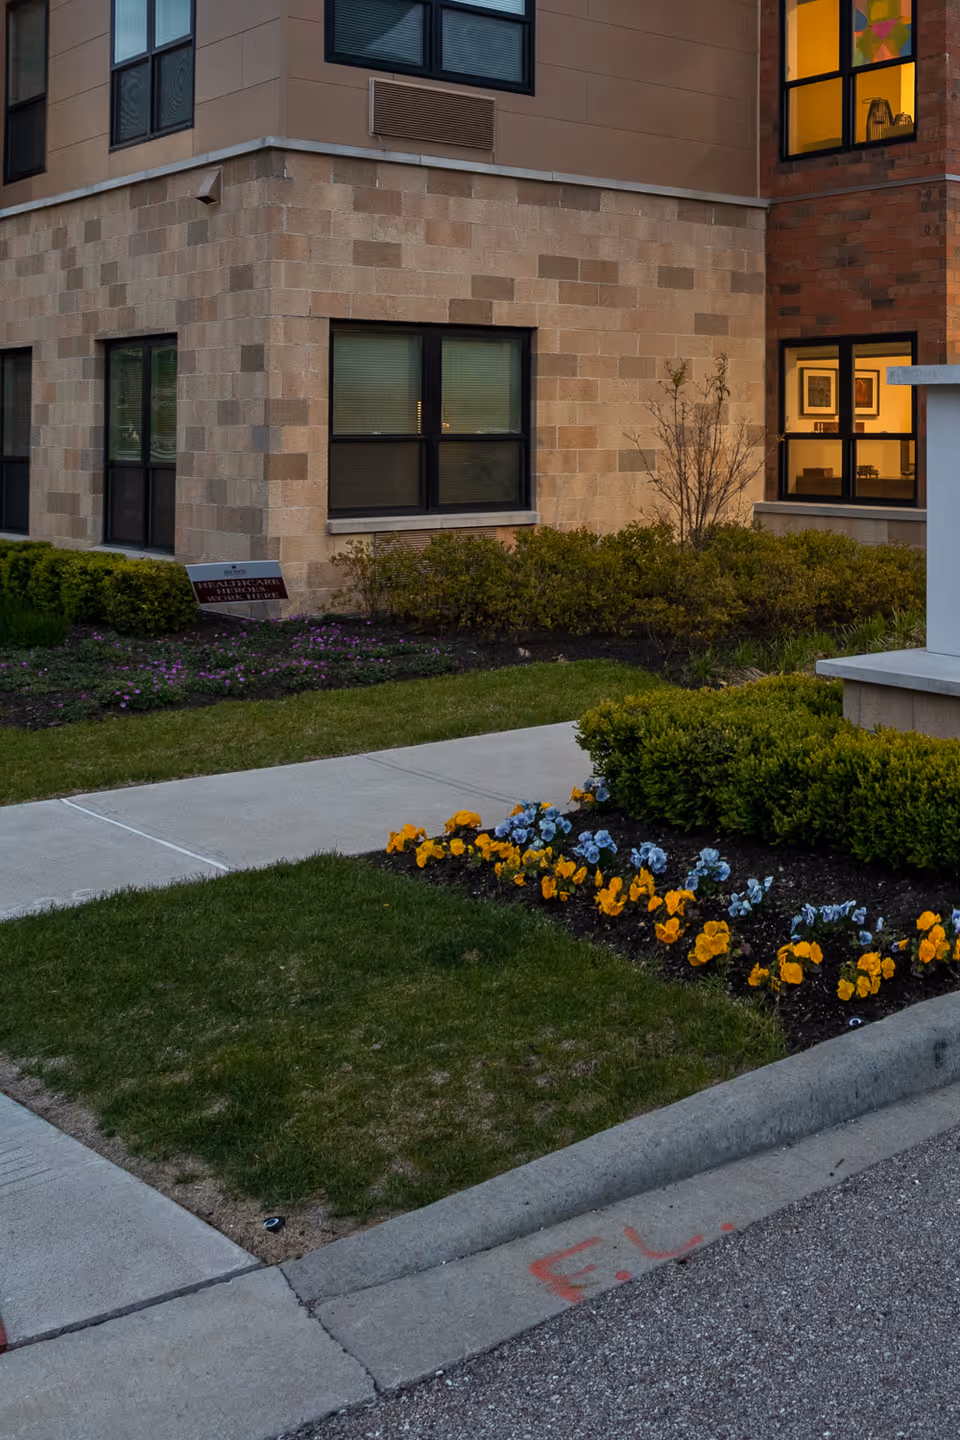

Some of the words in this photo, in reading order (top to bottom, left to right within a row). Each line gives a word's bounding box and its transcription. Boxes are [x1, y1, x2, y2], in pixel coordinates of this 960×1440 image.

[197, 578, 280, 589] HEALTHCARE
[216, 586, 266, 595] HEROES
[207, 594, 243, 602] WORK
[246, 592, 280, 600] HERE
